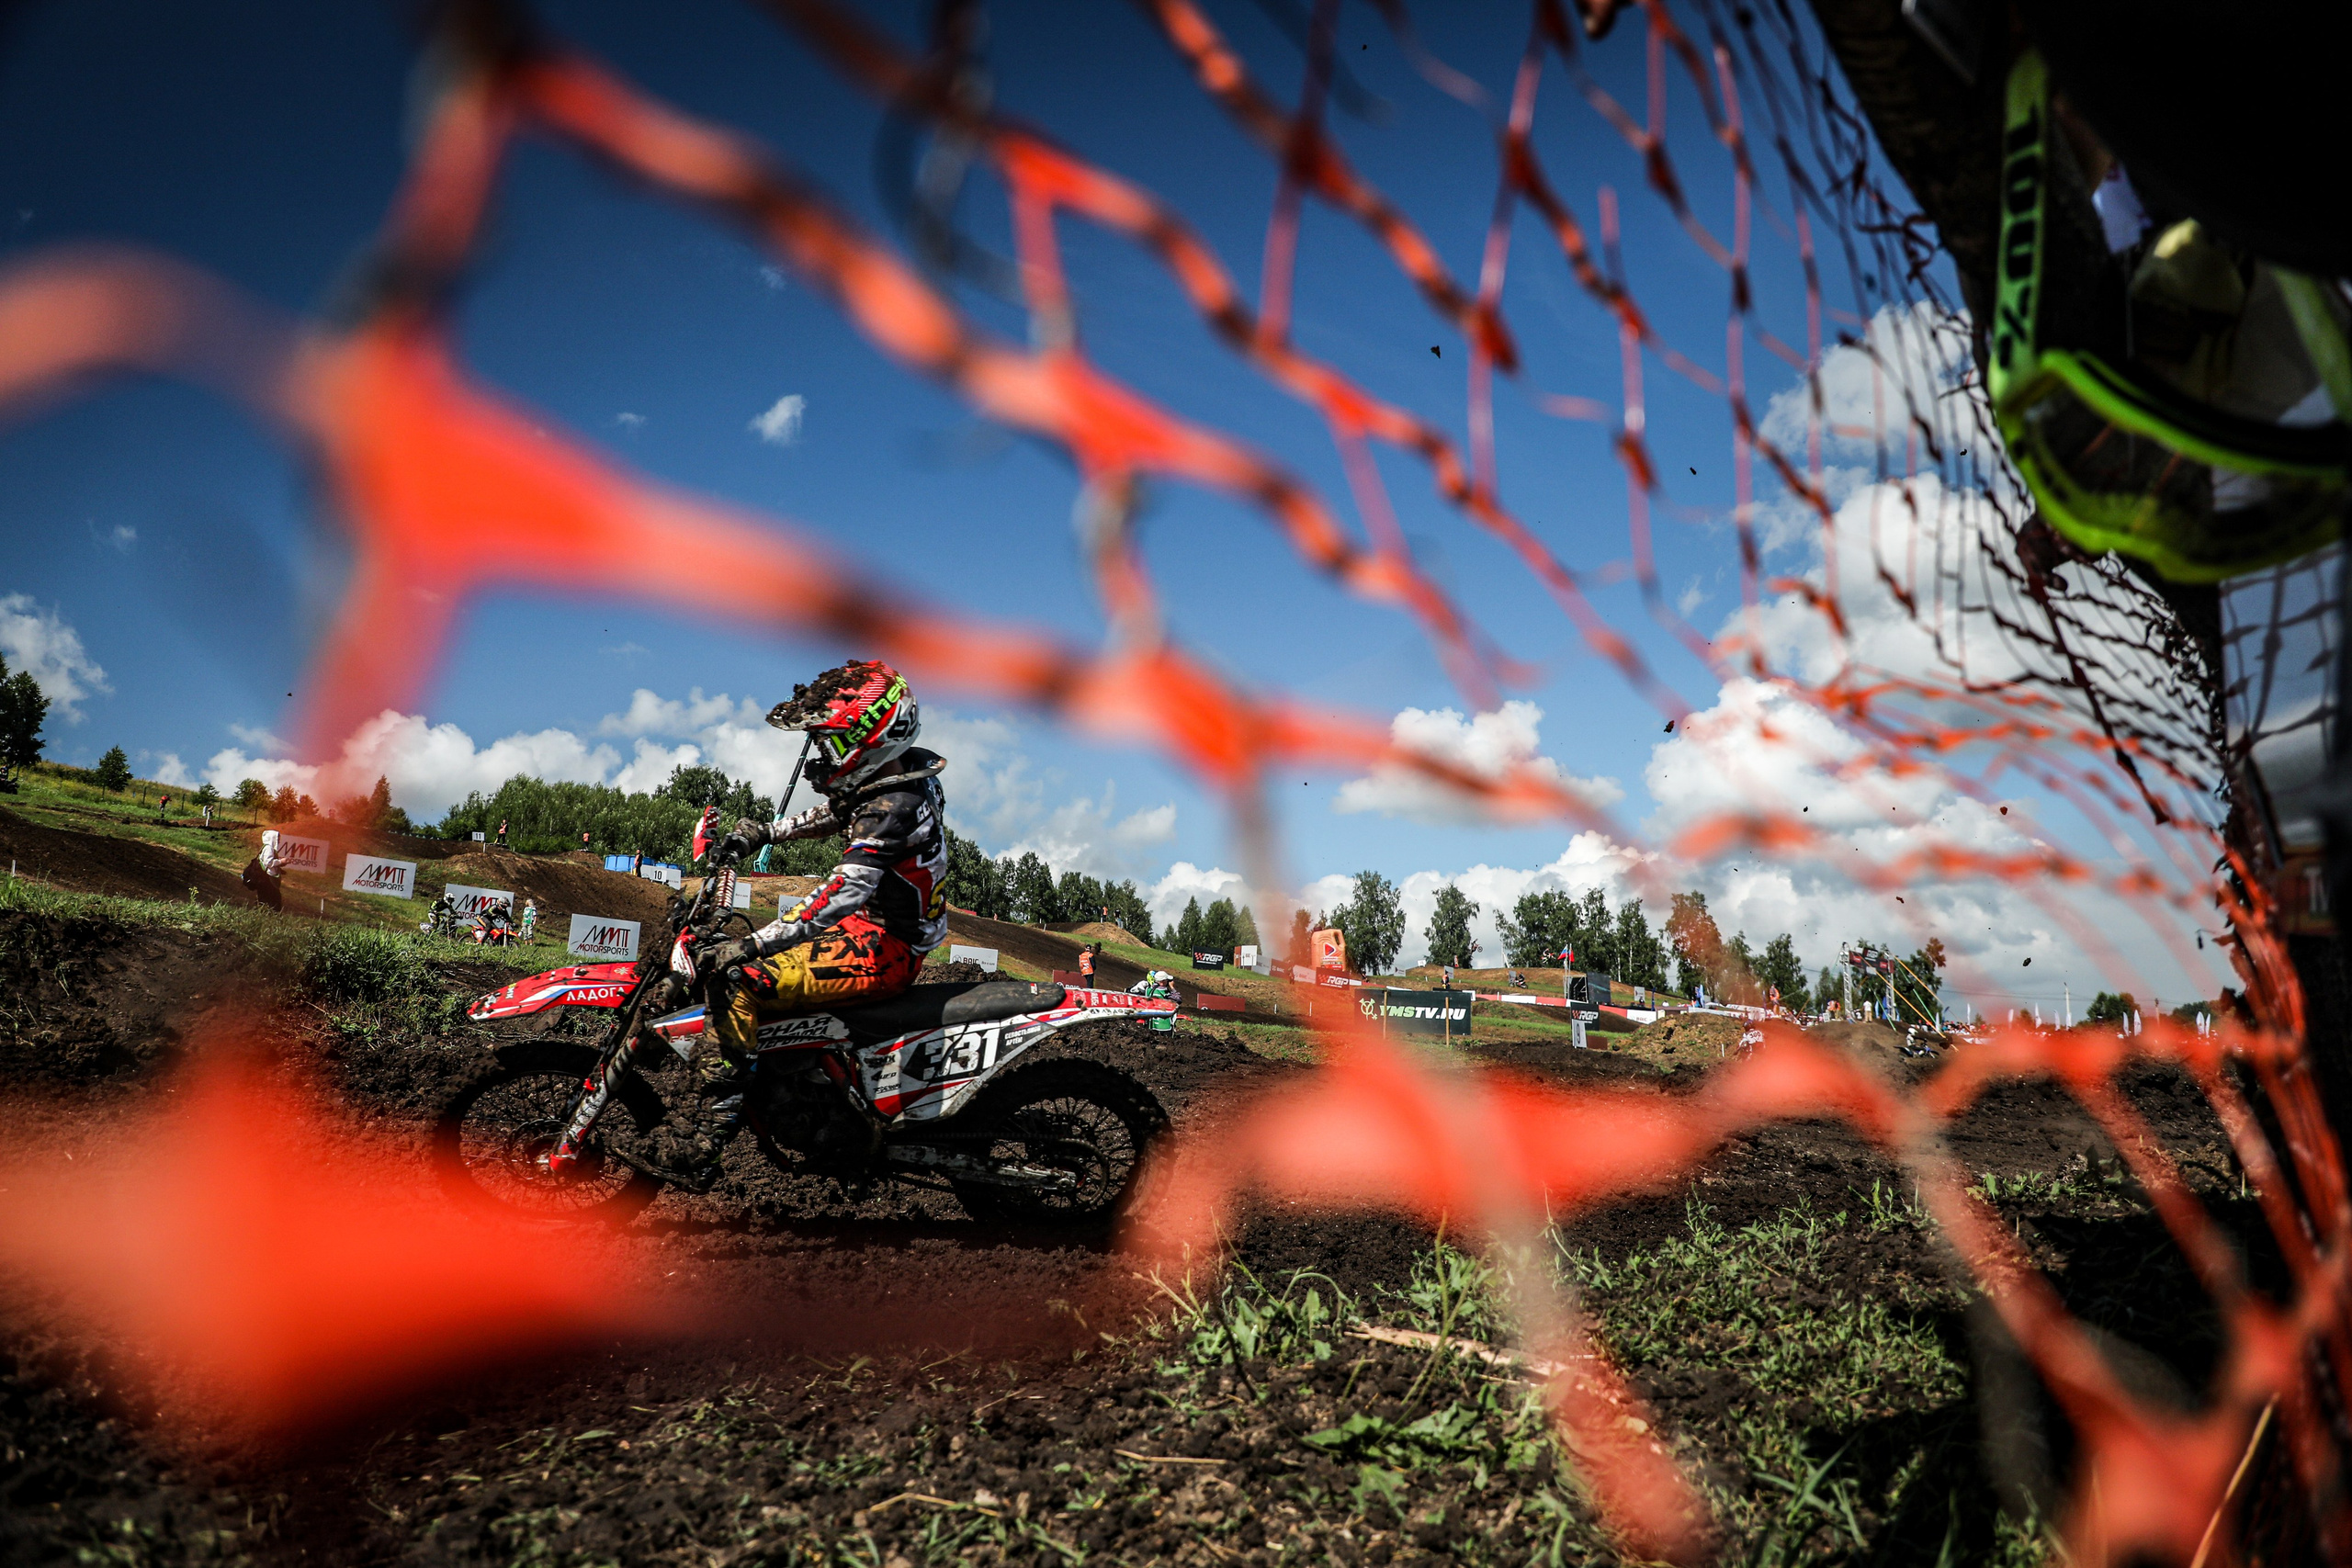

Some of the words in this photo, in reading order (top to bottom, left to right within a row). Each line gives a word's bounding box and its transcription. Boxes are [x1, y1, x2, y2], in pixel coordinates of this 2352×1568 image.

[654, 870, 662, 880] 10
[352, 879, 404, 892] MOTORSPORTS
[577, 942, 629, 956] MOTORSPORTS
[1203, 953, 1223, 962] RGP
[1327, 976, 1349, 986] RGP
[566, 986, 626, 1002] ЛАДОГА
[1379, 1005, 1467, 1021] YMSTV.RU
[1579, 1010, 1599, 1021] RGP
[1576, 1023, 1581, 1044] 9
[922, 1028, 1001, 1081] 331
